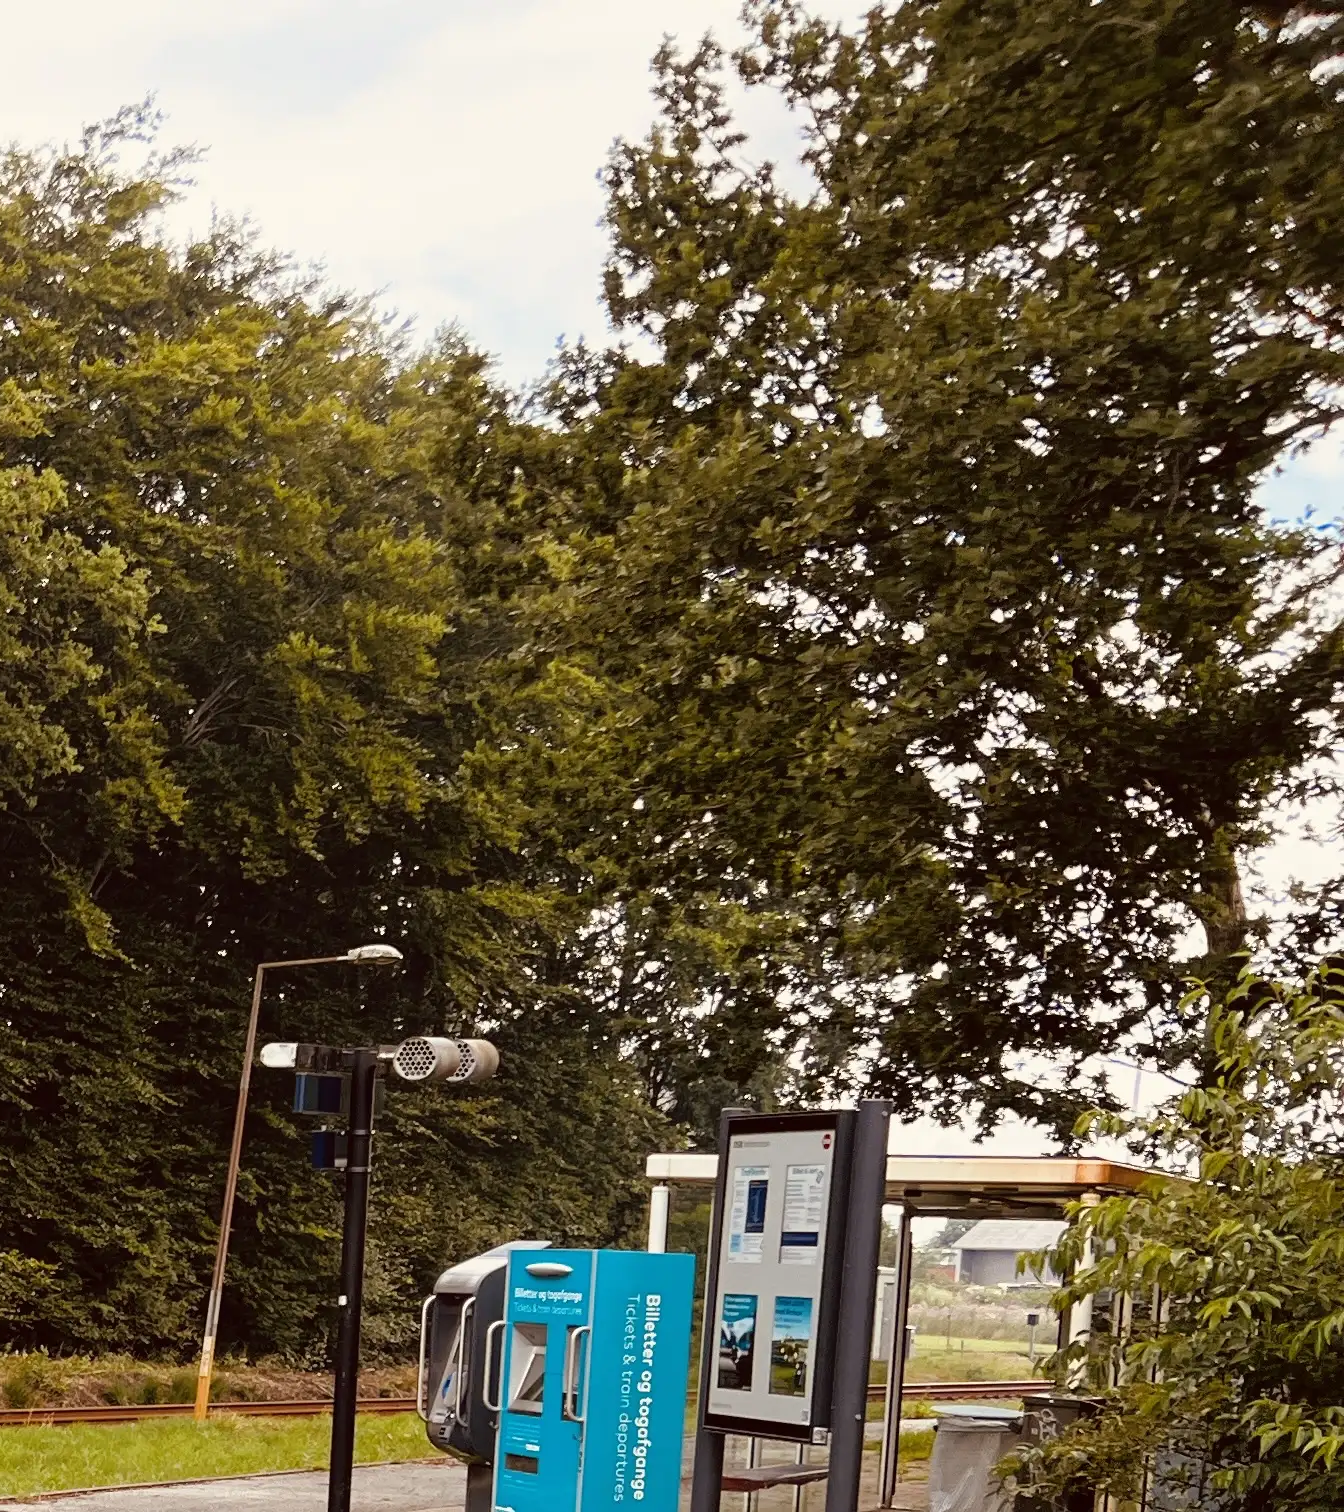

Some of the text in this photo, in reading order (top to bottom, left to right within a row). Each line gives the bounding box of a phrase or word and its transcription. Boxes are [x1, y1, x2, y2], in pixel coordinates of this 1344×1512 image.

[613, 1293, 641, 1503] Tickets & train departures
[629, 1293, 662, 1501] Billetter og togafgange
